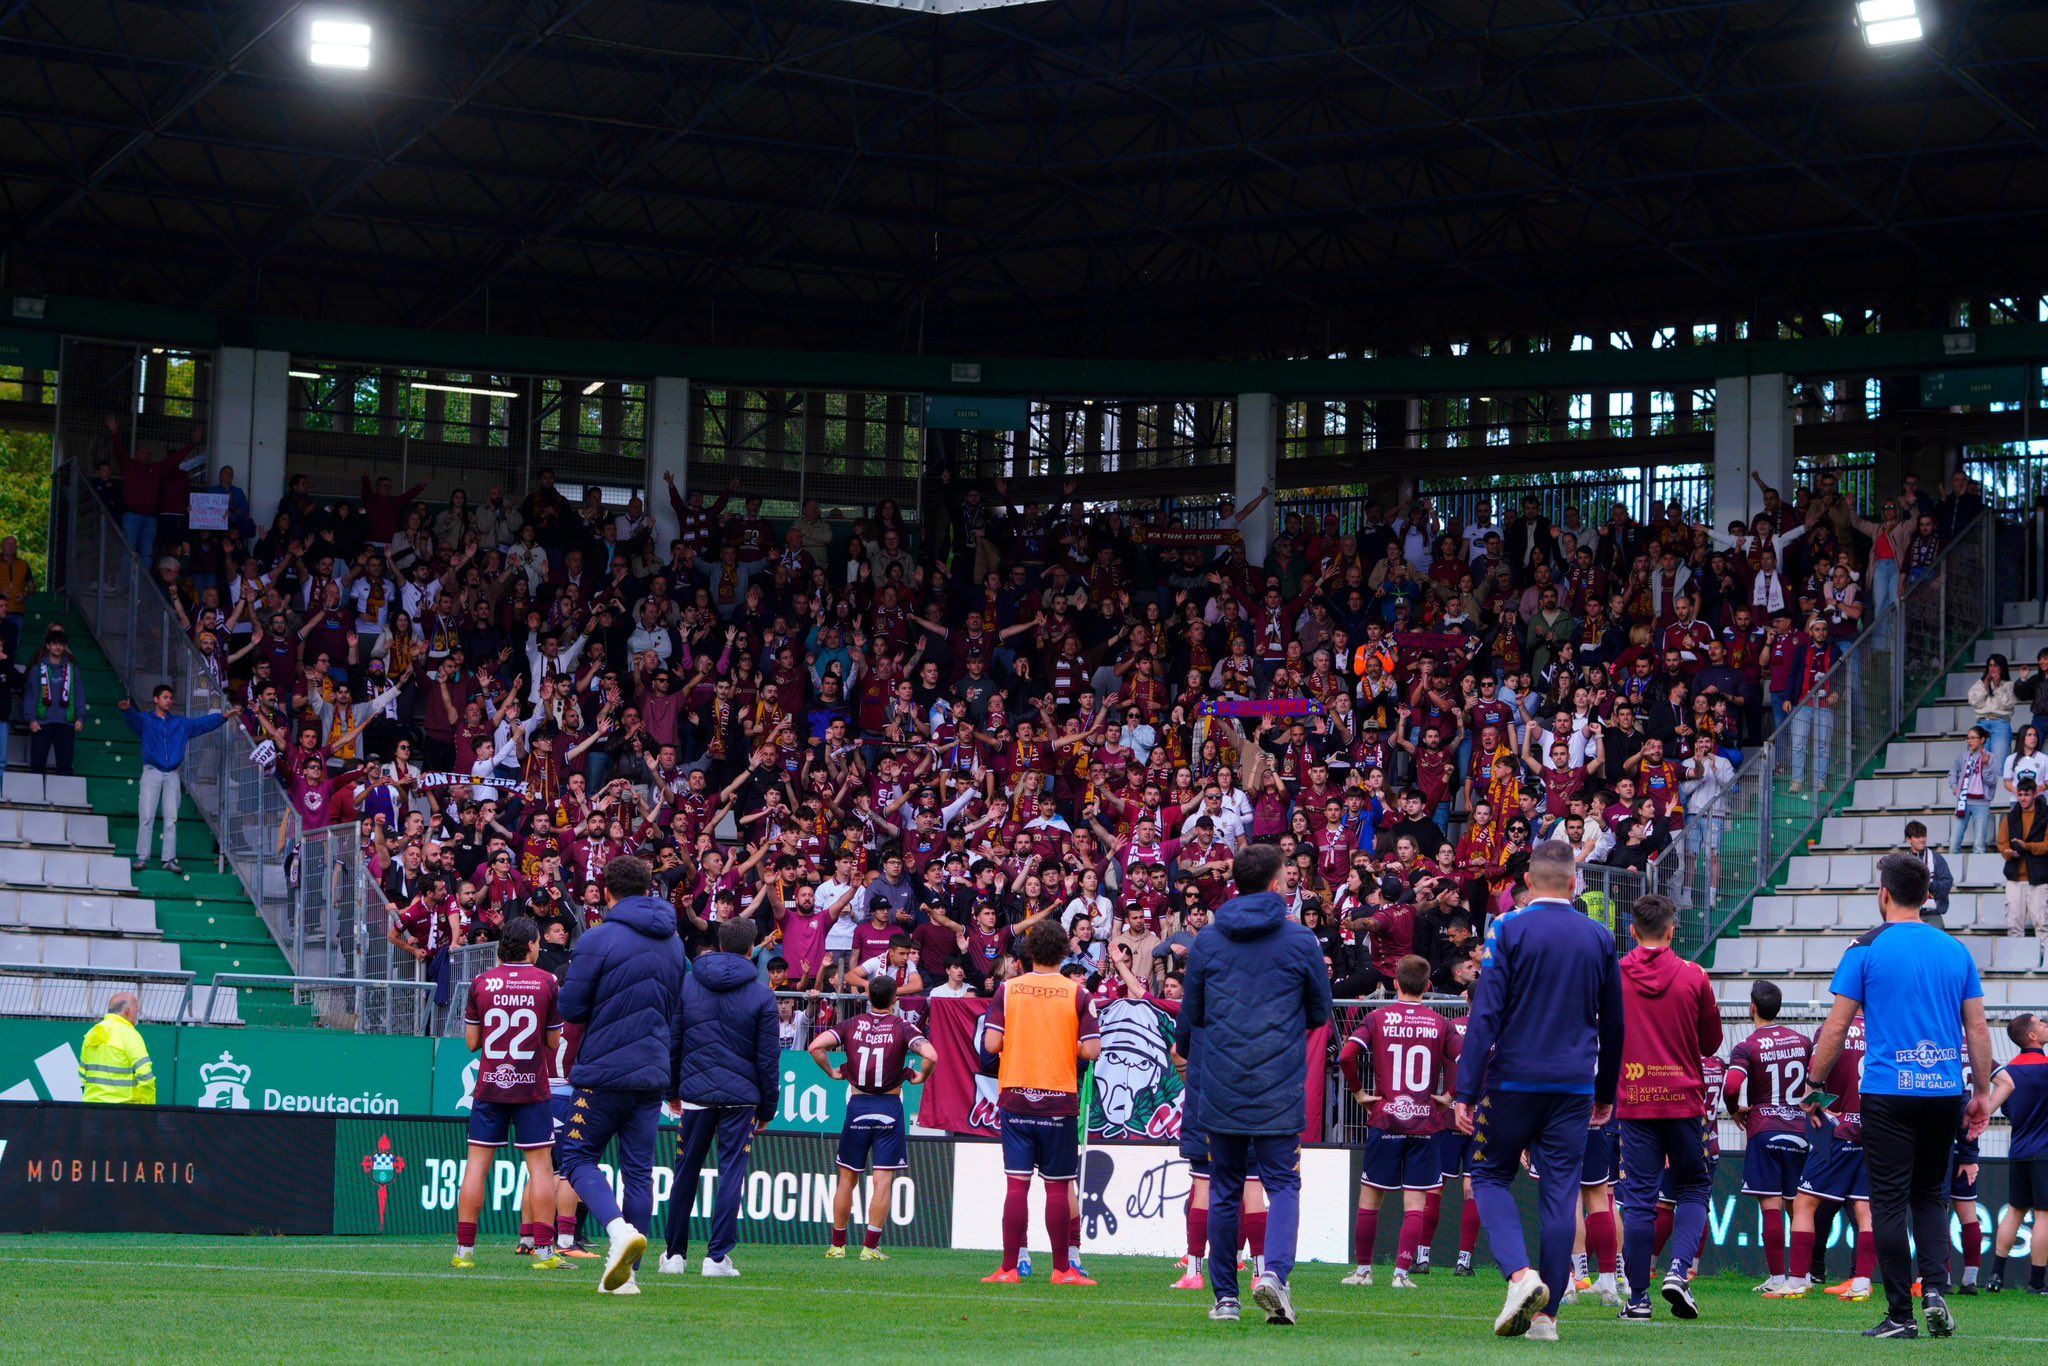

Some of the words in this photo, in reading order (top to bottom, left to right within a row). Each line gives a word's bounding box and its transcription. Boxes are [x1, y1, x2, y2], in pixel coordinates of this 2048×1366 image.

[506, 979, 541, 987] Deputación
[1011, 983, 1068, 998] Kappa
[493, 995, 535, 1007] COMPA
[484, 1008, 538, 1060] 22
[853, 1031, 863, 1041] M.
[865, 1033, 894, 1044] CUESTA
[1382, 1026, 1413, 1038] YELKO
[1416, 1027, 1438, 1039] PINO
[1760, 1050, 1776, 1063] FACU
[1776, 1047, 1806, 1061] BALLARDO
[1896, 1048, 1957, 1063] PESCAMAR
[857, 1046, 885, 1088] 11
[1387, 1043, 1432, 1092] 10
[1765, 1060, 1806, 1107] 12
[1927, 1081, 1957, 1089] GALICIA
[264, 1089, 399, 1115] Deputación
[1639, 1094, 1651, 1102] DE
[1653, 1094, 1687, 1102] GALICIA
[27, 1159, 195, 1184] MOBILIARIO
